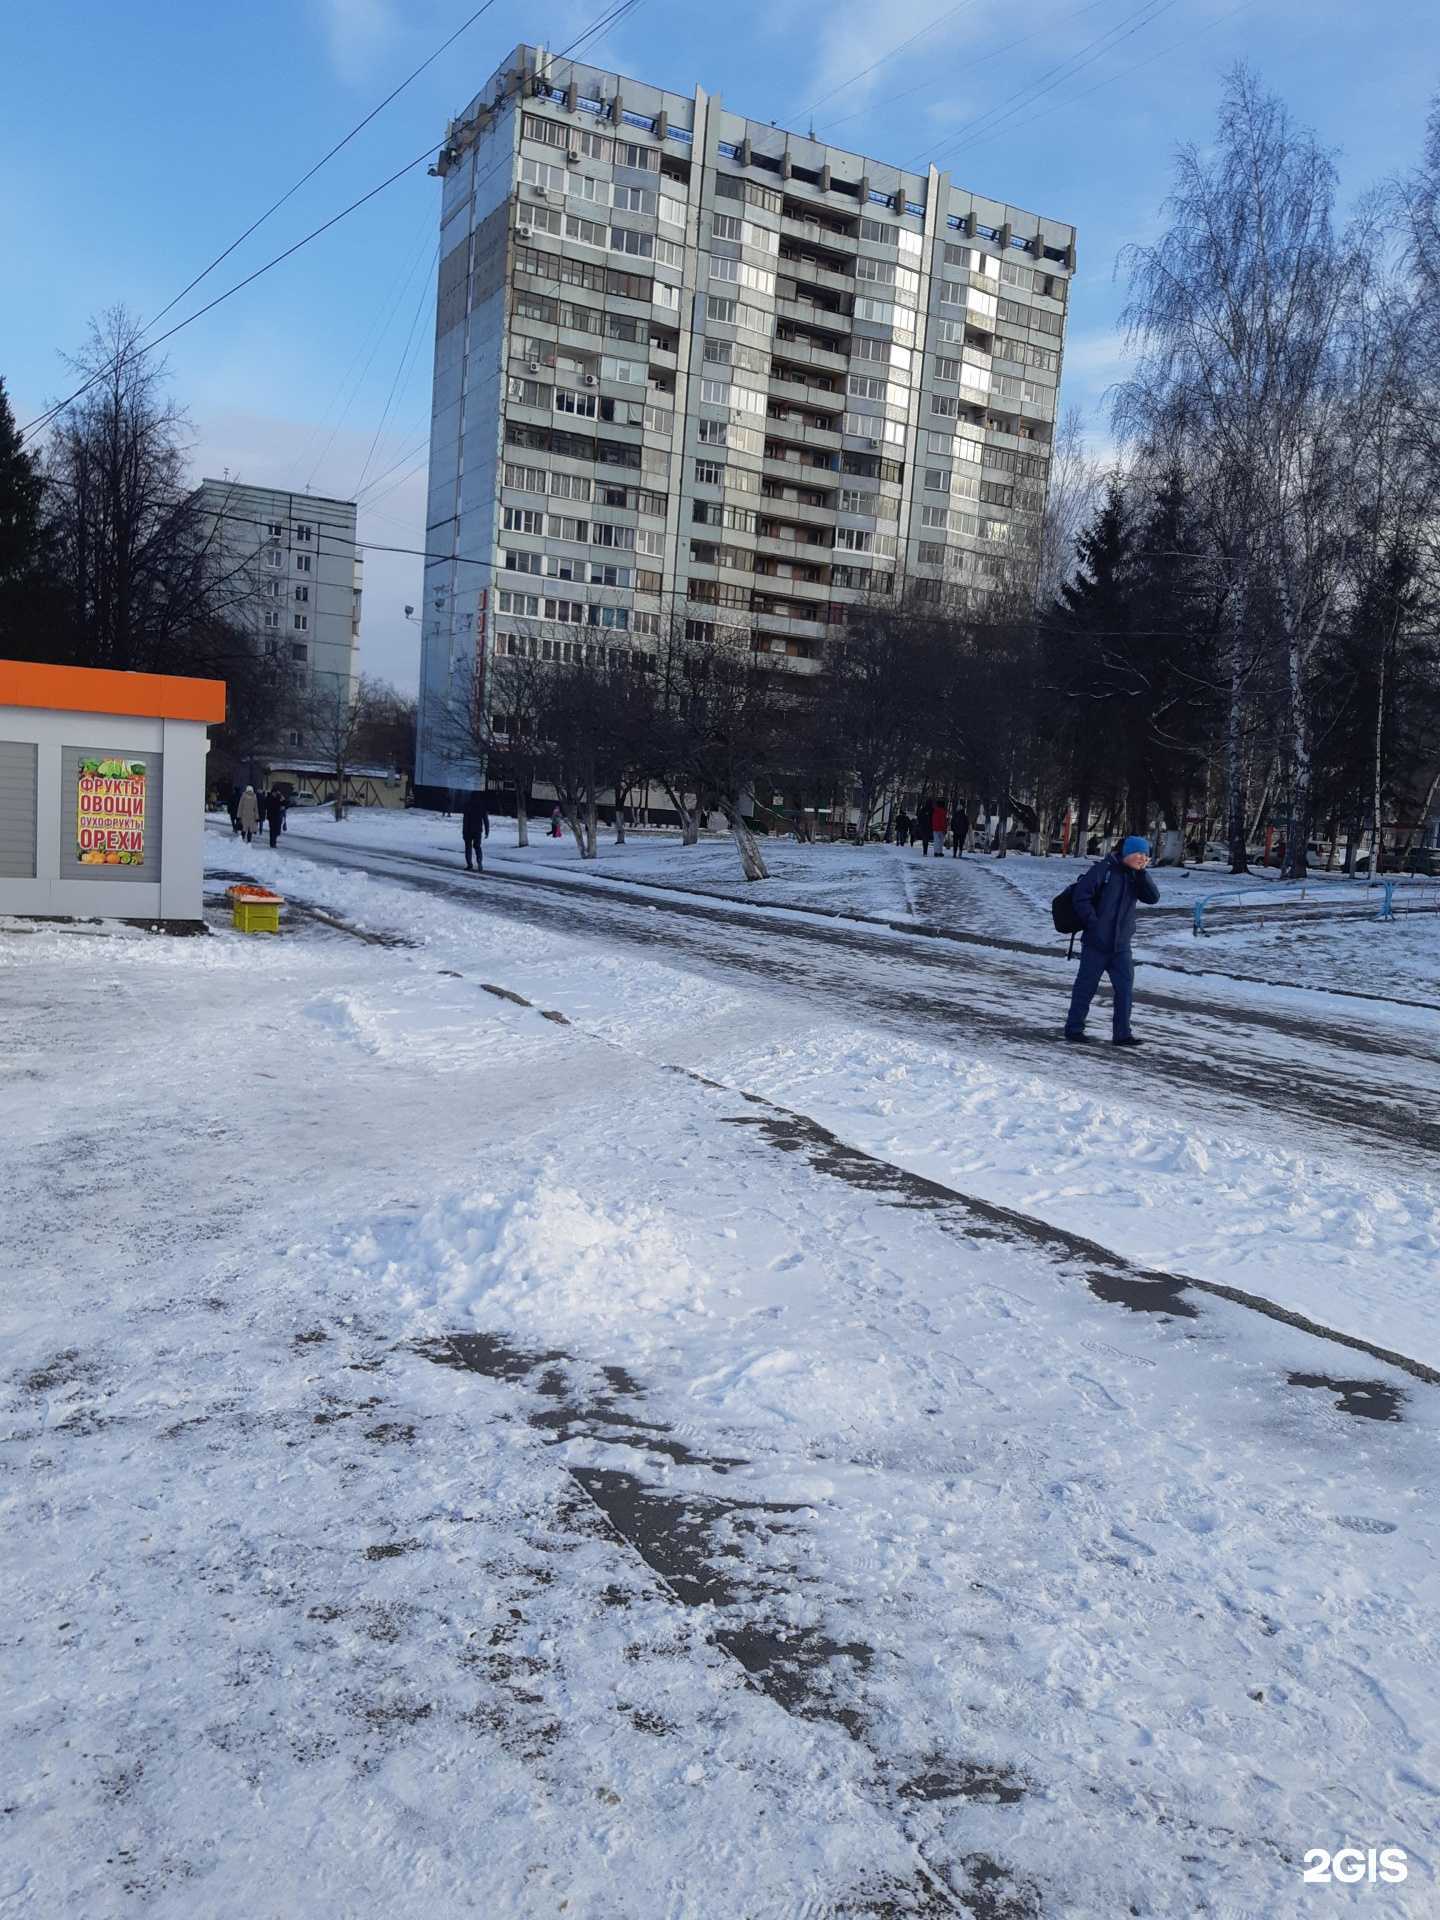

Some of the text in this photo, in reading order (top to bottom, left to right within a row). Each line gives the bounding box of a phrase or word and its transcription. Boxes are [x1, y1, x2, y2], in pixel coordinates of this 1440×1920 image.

[80, 779, 144, 795] ФРУКТЫ
[80, 795, 143, 816] ОВОЩИ
[80, 829, 142, 850] ОРЕХИ
